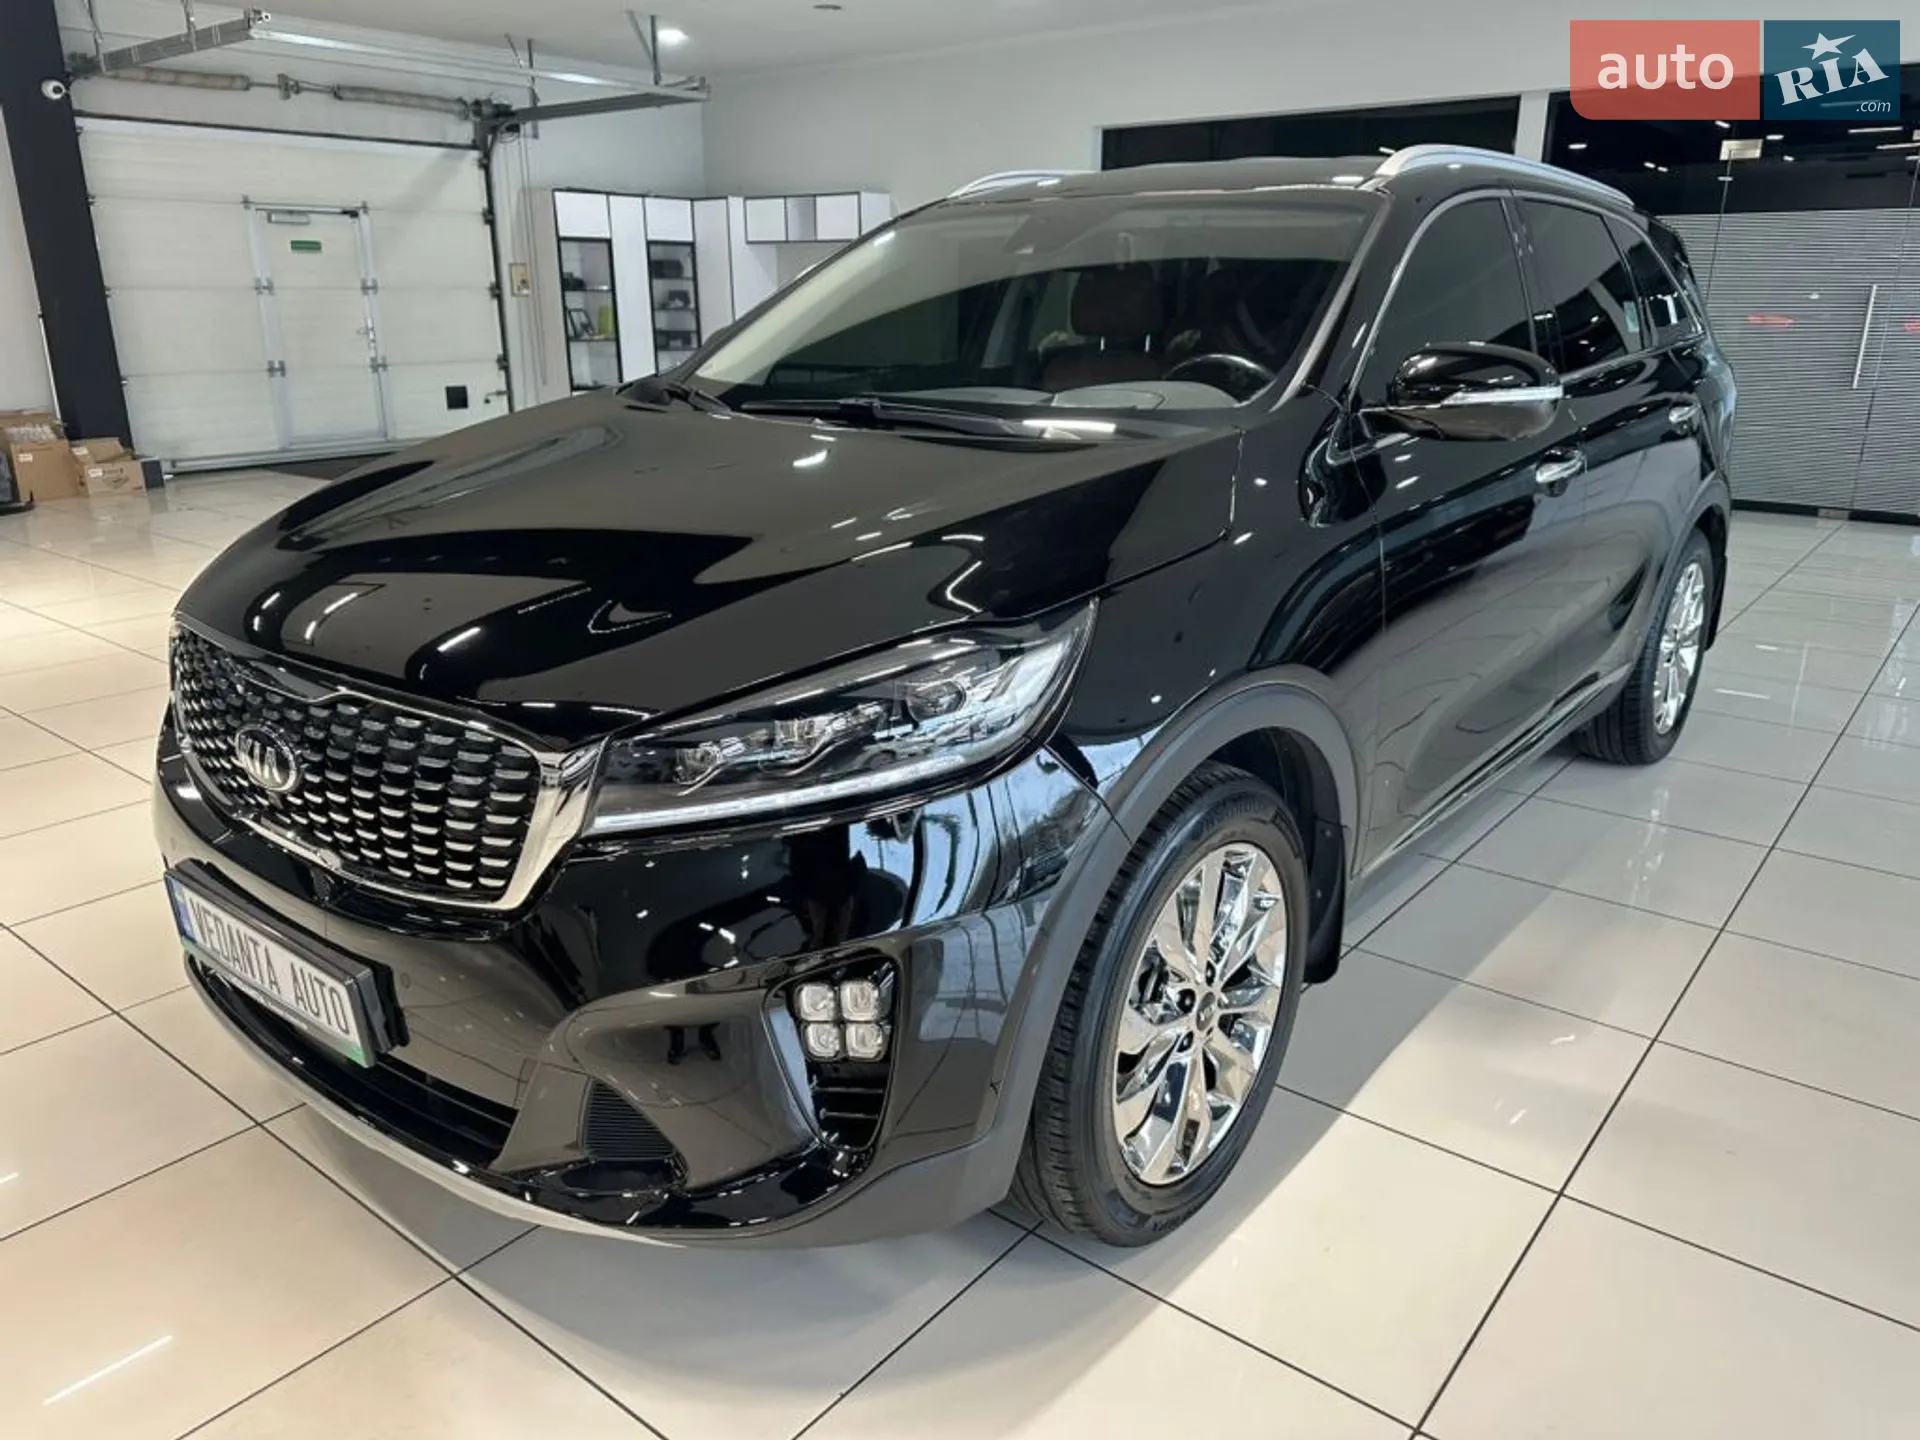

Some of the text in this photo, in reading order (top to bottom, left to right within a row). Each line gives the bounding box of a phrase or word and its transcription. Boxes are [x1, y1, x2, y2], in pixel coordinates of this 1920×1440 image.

[239, 734, 283, 784] KIA
[189, 896, 350, 1035] VEDANTA AUTO
